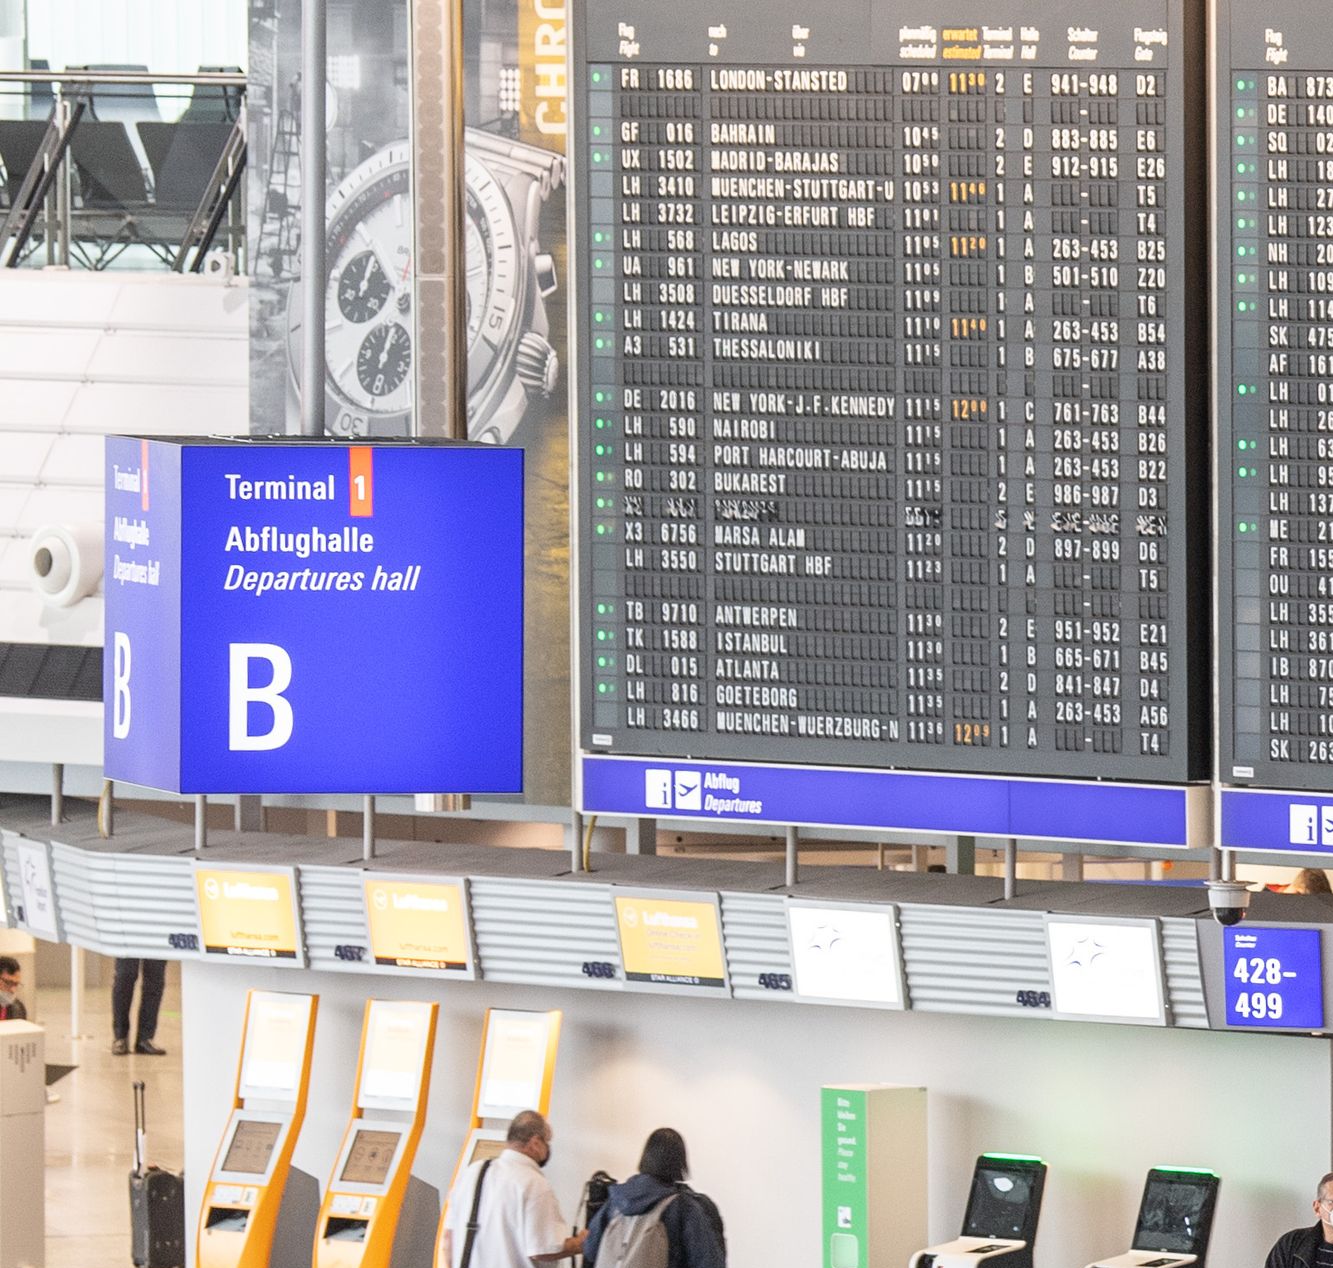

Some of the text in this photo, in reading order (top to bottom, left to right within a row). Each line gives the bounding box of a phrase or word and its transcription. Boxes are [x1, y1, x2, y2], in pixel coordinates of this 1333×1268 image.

[620, 68, 1157, 95] FR 1686 LONDON-STANSTED 941-948 D2
[1266, 75, 1288, 96] BA
[709, 123, 776, 144] BAHRAIN
[710, 150, 840, 172] MADRID-BARAJAS
[711, 231, 759, 252] LAGOS
[712, 337, 821, 360] THESSALONIKI
[712, 418, 776, 439] NAIROBI
[225, 473, 366, 500] Terminal 1
[713, 471, 787, 493] BUKAREST
[225, 526, 374, 557] Abflughalle
[223, 564, 421, 596] Departures hall
[716, 631, 789, 654] ISTANBUL
[714, 658, 780, 680] ATLANTA
[113, 631, 132, 740] B
[229, 642, 294, 752] B
[715, 684, 798, 708] GOETEBORG
[703, 771, 740, 794] Abflug
[704, 794, 763, 814] Departures
[1234, 957, 1297, 985] 428-
[1235, 992, 1283, 1020] 499
